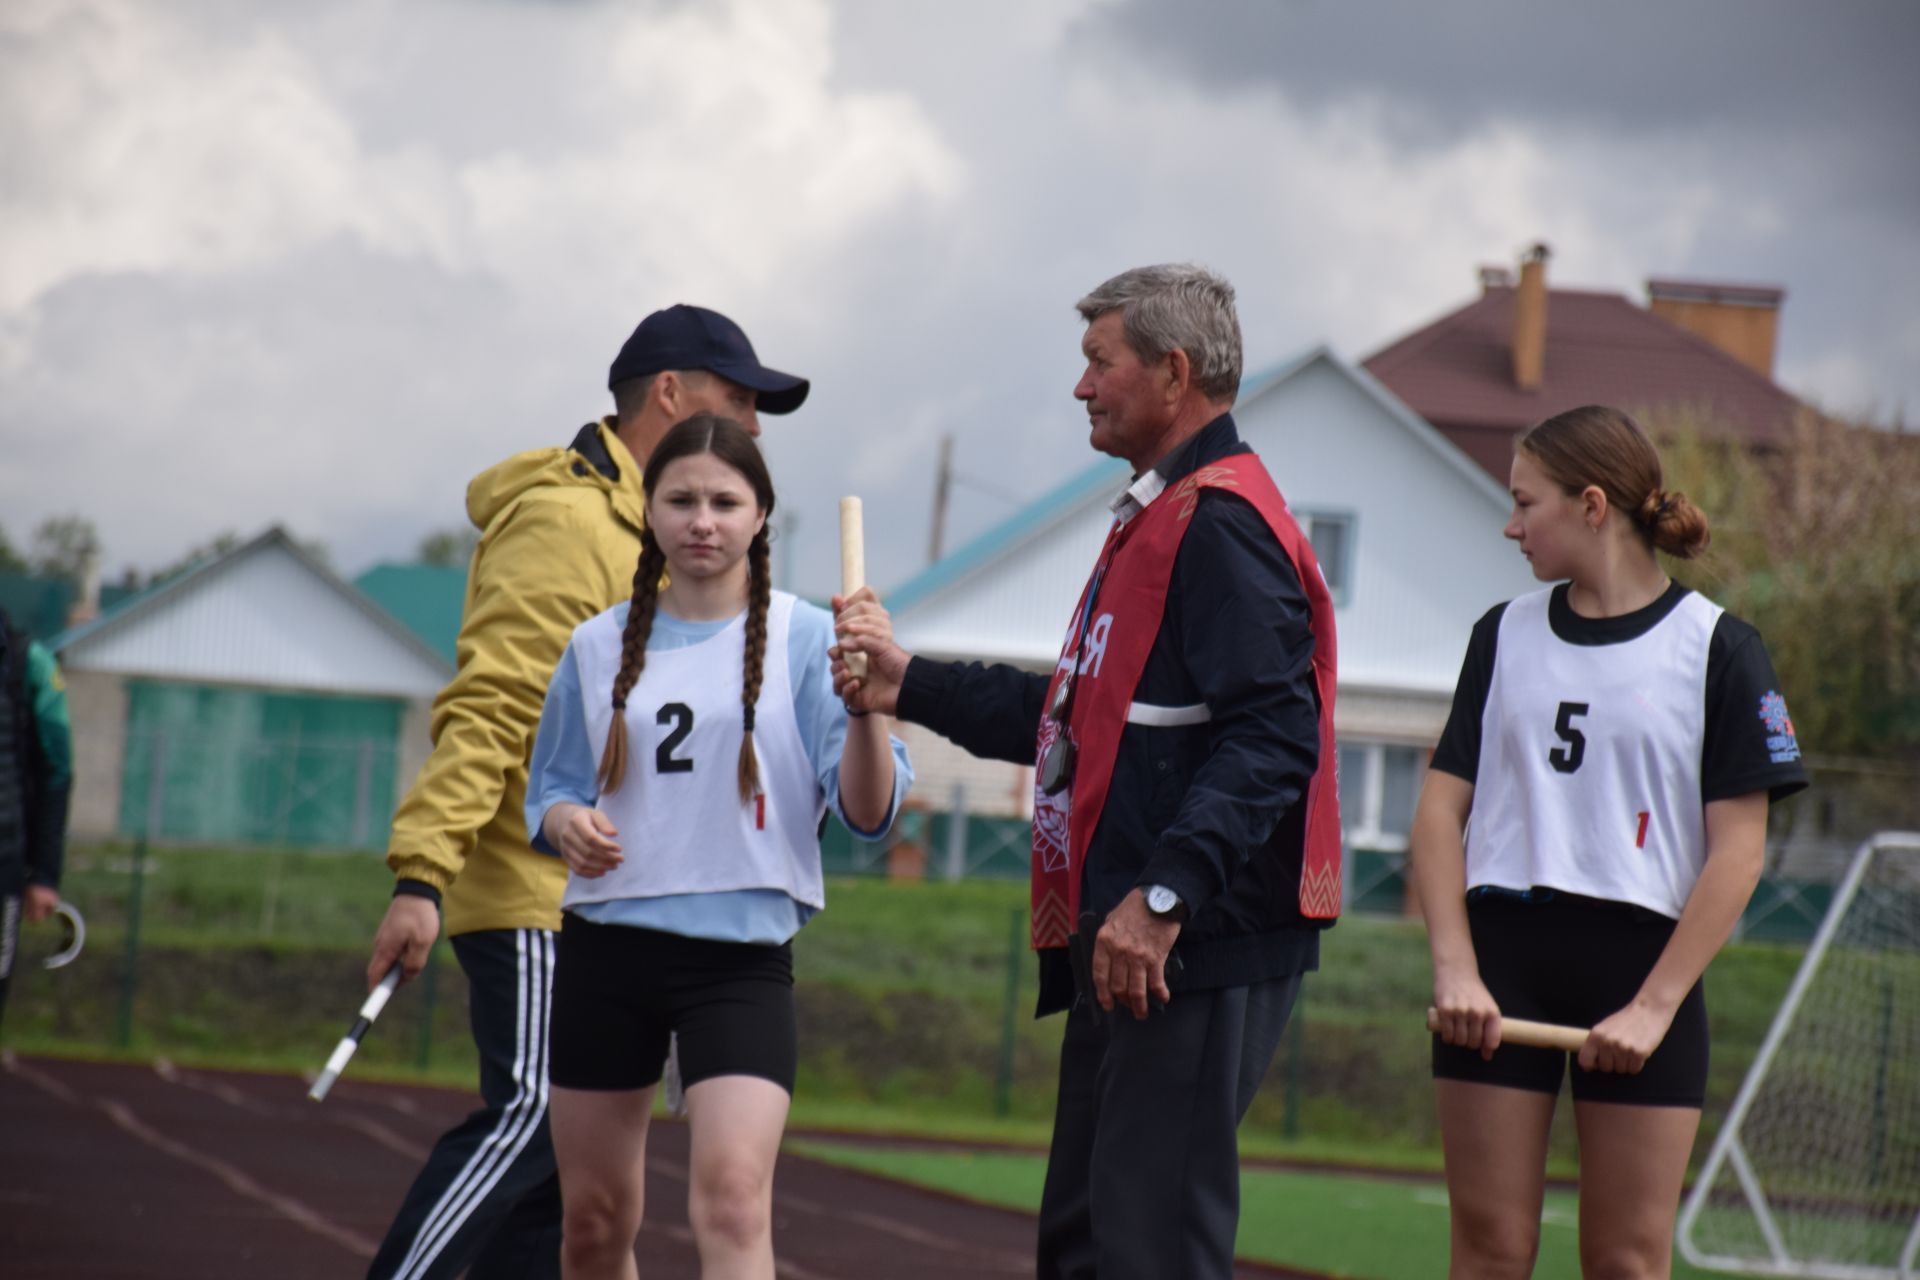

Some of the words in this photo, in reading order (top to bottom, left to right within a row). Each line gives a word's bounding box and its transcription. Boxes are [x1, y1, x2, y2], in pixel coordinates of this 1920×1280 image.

[656, 702, 694, 774] 2
[1549, 701, 1590, 774] 5
[754, 793, 765, 831] 1
[1635, 811, 1650, 849] 1
